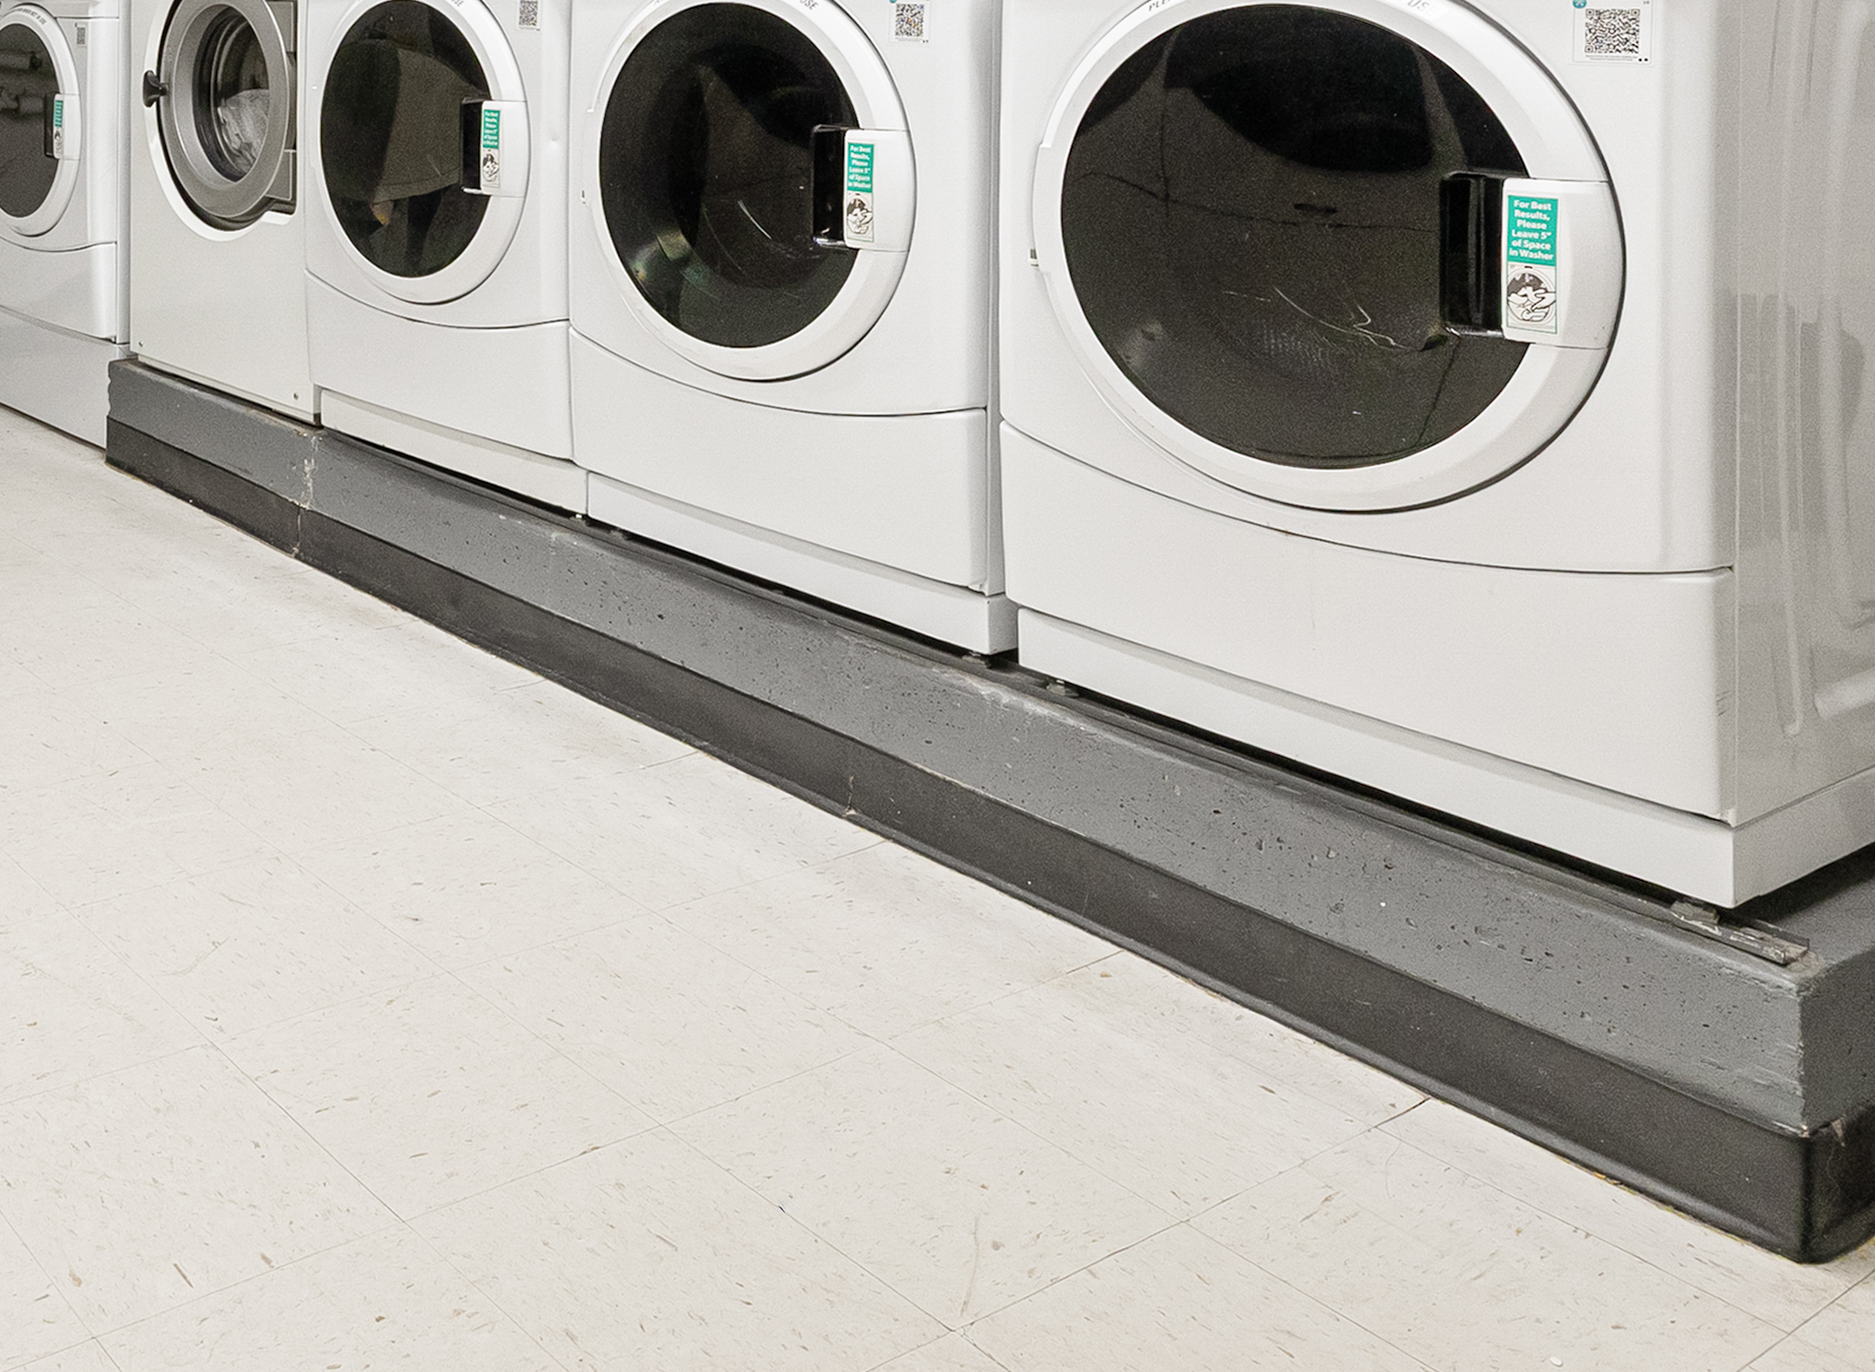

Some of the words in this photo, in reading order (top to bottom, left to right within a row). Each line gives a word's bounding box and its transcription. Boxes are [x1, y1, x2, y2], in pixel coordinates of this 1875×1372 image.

[1514, 200, 1529, 209] For
[1531, 201, 1552, 211] Best
[1514, 209, 1550, 221] Results,
[1517, 220, 1547, 230] Please
[1511, 230, 1539, 239] Leave
[1512, 239, 1522, 247] of
[1522, 240, 1552, 251] Space
[1519, 249, 1554, 261] Washer
